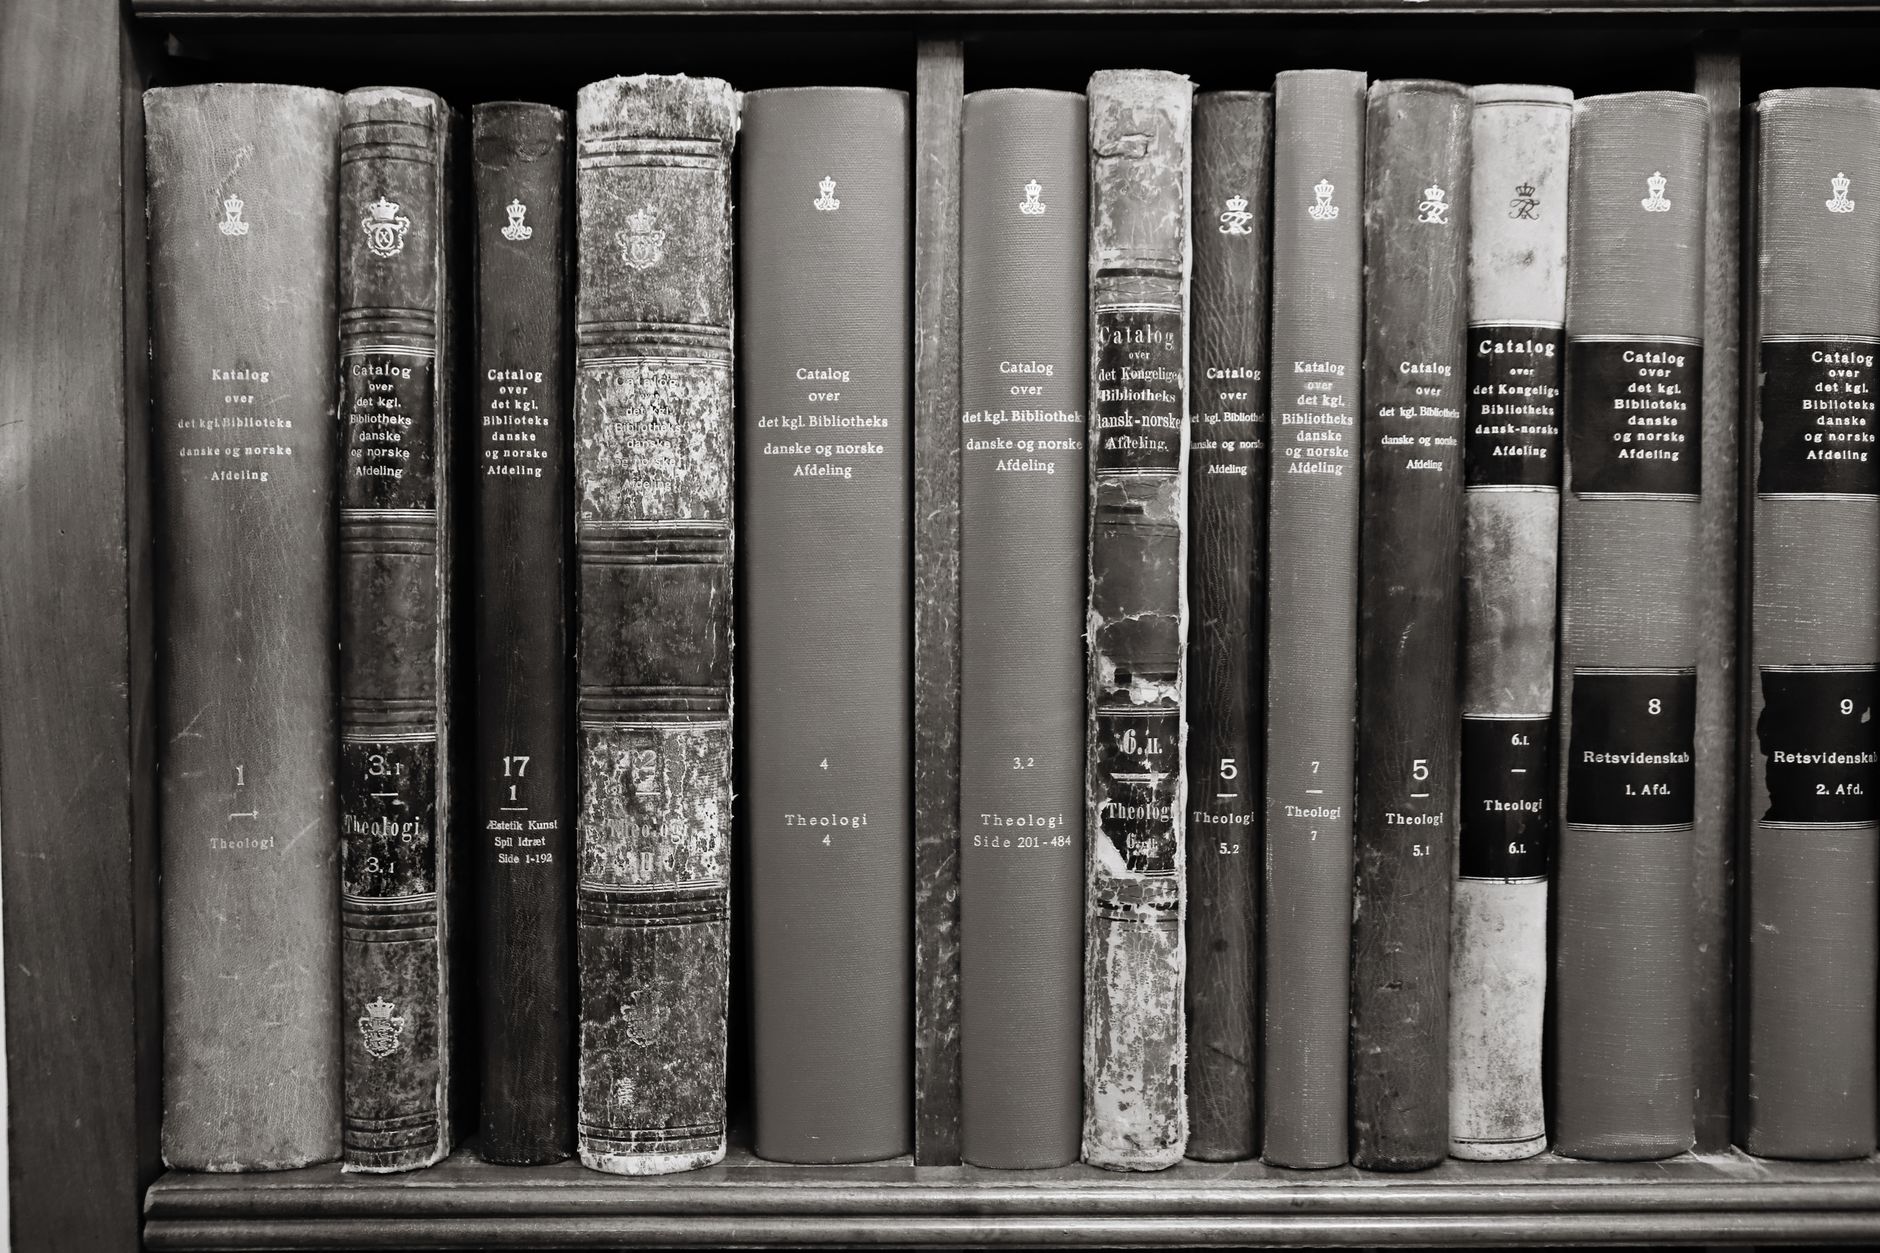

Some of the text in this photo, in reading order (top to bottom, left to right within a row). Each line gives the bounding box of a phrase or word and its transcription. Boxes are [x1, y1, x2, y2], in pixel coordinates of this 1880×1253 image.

[1100, 324, 1174, 350] Catalog
[1480, 340, 1555, 357] Catalog
[1128, 351, 1150, 360] over
[1622, 351, 1685, 367] Catalog
[1811, 351, 1874, 367] Catalog
[352, 364, 412, 379] Catalog
[796, 368, 850, 382] Catalog
[1000, 361, 1054, 376] Catalog
[1099, 368, 1116, 381] det
[1206, 367, 1261, 380] Catalog
[1294, 361, 1345, 376] Katalog
[1400, 361, 1452, 376] Catalog
[1509, 368, 1535, 376] over
[1639, 367, 1671, 377] over
[1828, 369, 1860, 378] over
[212, 369, 270, 383] Katalog
[487, 369, 543, 383] Catalog
[368, 382, 394, 392] over
[499, 386, 528, 395] over
[1010, 385, 1043, 395] over
[1307, 382, 1333, 391] over
[1416, 386, 1442, 397] over
[1473, 384, 1559, 398] det Kongelige
[1628, 382, 1681, 396] det kgl.
[1815, 382, 1869, 395] det kgl.
[225, 394, 254, 403] over
[808, 392, 840, 401] over
[1101, 387, 1176, 403] Bibliotheks
[1220, 391, 1247, 400] over
[1297, 394, 1345, 408] det kgl.
[356, 396, 402, 409] det kgl.
[491, 400, 539, 412] det kgl.
[1614, 399, 1687, 411] Biblioteks
[1802, 399, 1875, 411] Biblioteks
[1379, 407, 1395, 417] det
[1400, 407, 1417, 419] kgl.
[1481, 404, 1555, 416] Bibliotheks
[178, 418, 196, 428] det
[221, 416, 292, 428] Biblioteks
[350, 413, 412, 425] Bibliotheks
[483, 415, 549, 426] Biblioteks
[758, 415, 888, 430] det kgl. Bibliotheks
[962, 411, 982, 423] det
[984, 410, 1009, 425] kgl.
[1191, 413, 1200, 423] et
[1204, 413, 1221, 425] kgl.
[1282, 413, 1353, 426] Bibliotheks
[1628, 415, 1678, 426] danske
[1816, 415, 1867, 426] danske
[1297, 430, 1341, 441] danske
[1475, 423, 1559, 435] dansk-norske
[358, 431, 401, 441] danske
[491, 430, 536, 442] danske
[1381, 434, 1415, 445] danske
[1418, 436, 1431, 446] og
[1613, 431, 1685, 443] og norske
[1804, 432, 1876, 443] og norske
[180, 444, 292, 457] danske og norske
[763, 442, 884, 457] danske og norske
[966, 438, 1083, 452] danske og norske
[1221, 441, 1235, 452] og
[351, 447, 410, 458] og norske
[485, 448, 548, 459] og norske
[1285, 446, 1349, 459] og norske
[1493, 446, 1547, 458] Afdeling
[1618, 449, 1679, 462] Afdeling
[1806, 450, 1868, 462] Afdeling
[355, 465, 403, 478] Afdeling
[487, 465, 542, 478] Afdeling
[793, 464, 852, 479] Afdeling
[995, 459, 1055, 474] Afdeling
[1208, 465, 1248, 475] Afdeling
[1288, 461, 1343, 476] Afdeling
[1406, 459, 1443, 471] Afdeling
[211, 471, 269, 482] Afdeling
[1648, 698, 1661, 714] 8
[1840, 699, 1853, 715] 9
[819, 757, 829, 770] 4
[1013, 757, 1034, 769] 3.2
[1583, 751, 1690, 764] Retsvidenskab
[502, 755, 530, 777] 17
[1220, 758, 1238, 780] 5
[1311, 761, 1320, 773] 7
[1412, 759, 1429, 780] 5
[236, 765, 245, 786] 1
[508, 784, 518, 801] 1
[1625, 784, 1671, 796] 1. Afd.
[1816, 783, 1864, 795] 2. Afd.
[1285, 805, 1341, 819] Theologi
[1483, 799, 1543, 812] Theologi
[784, 813, 868, 828] Theologi
[981, 814, 1064, 828] Theologi
[1193, 811, 1255, 825] Theologi
[1385, 812, 1444, 826] Theologi
[345, 815, 421, 842] Theologi
[486, 819, 558, 831] Æstetik Kunst
[822, 834, 832, 846] 4
[973, 834, 1011, 847] Side
[1310, 831, 1318, 840] 7
[210, 836, 274, 850] Theologi
[494, 836, 546, 849] Spil Idræt
[1219, 842, 1240, 854] 5.2
[1412, 844, 1431, 857] 5.1
[498, 852, 553, 864] Side 1-192
